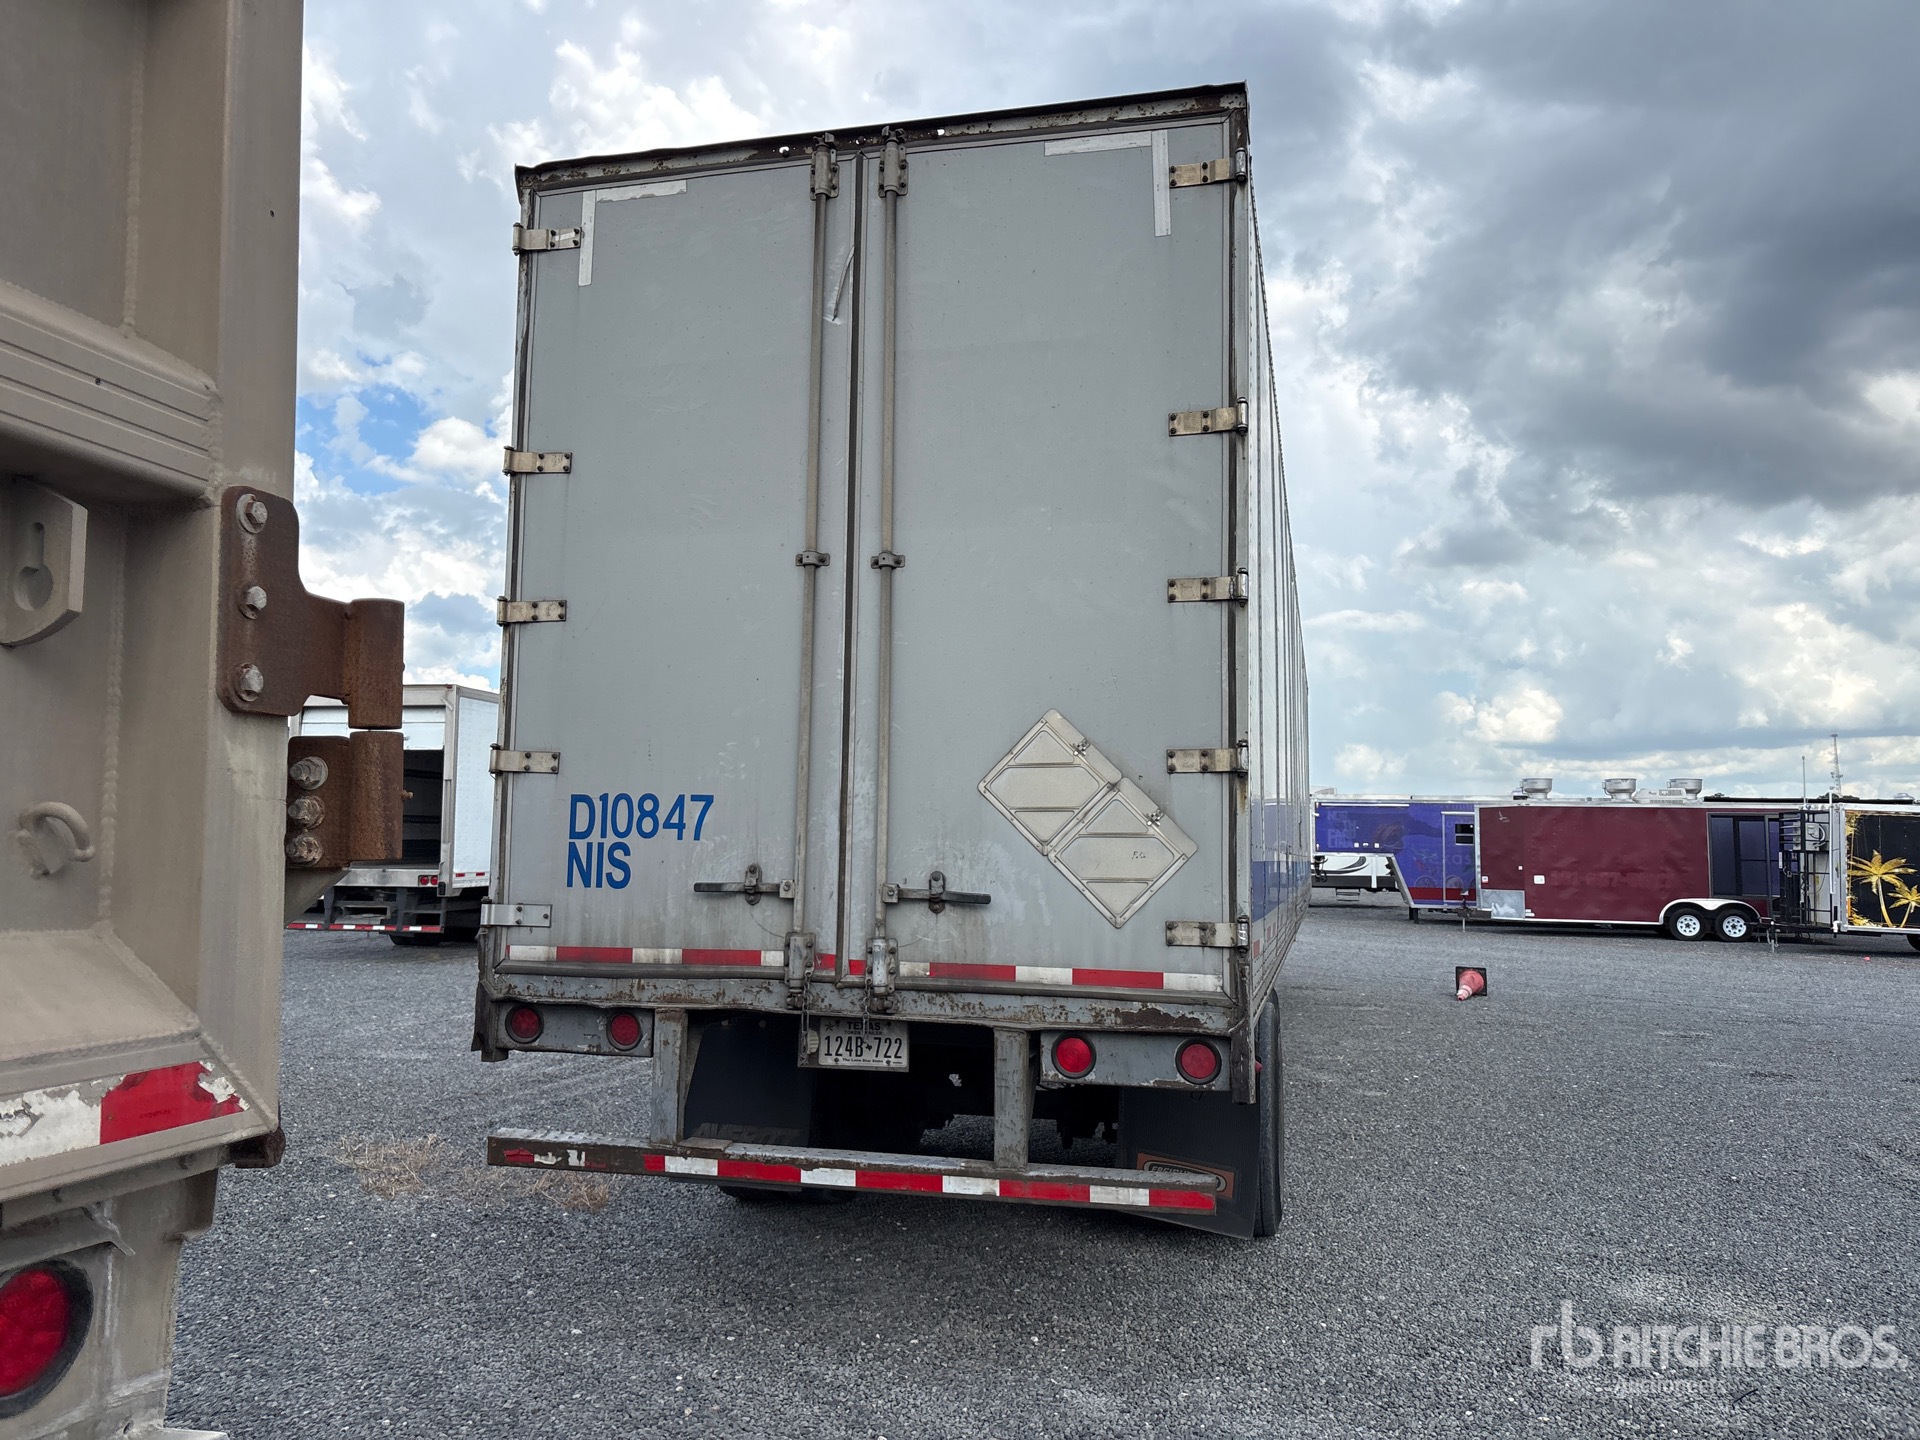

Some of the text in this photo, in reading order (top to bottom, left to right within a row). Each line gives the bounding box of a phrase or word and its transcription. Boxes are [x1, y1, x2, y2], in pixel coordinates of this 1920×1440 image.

[569, 792, 714, 841] D10847
[566, 841, 631, 889] NIS
[847, 1021, 881, 1031] TEXAS
[824, 1035, 902, 1059] 124B 722
